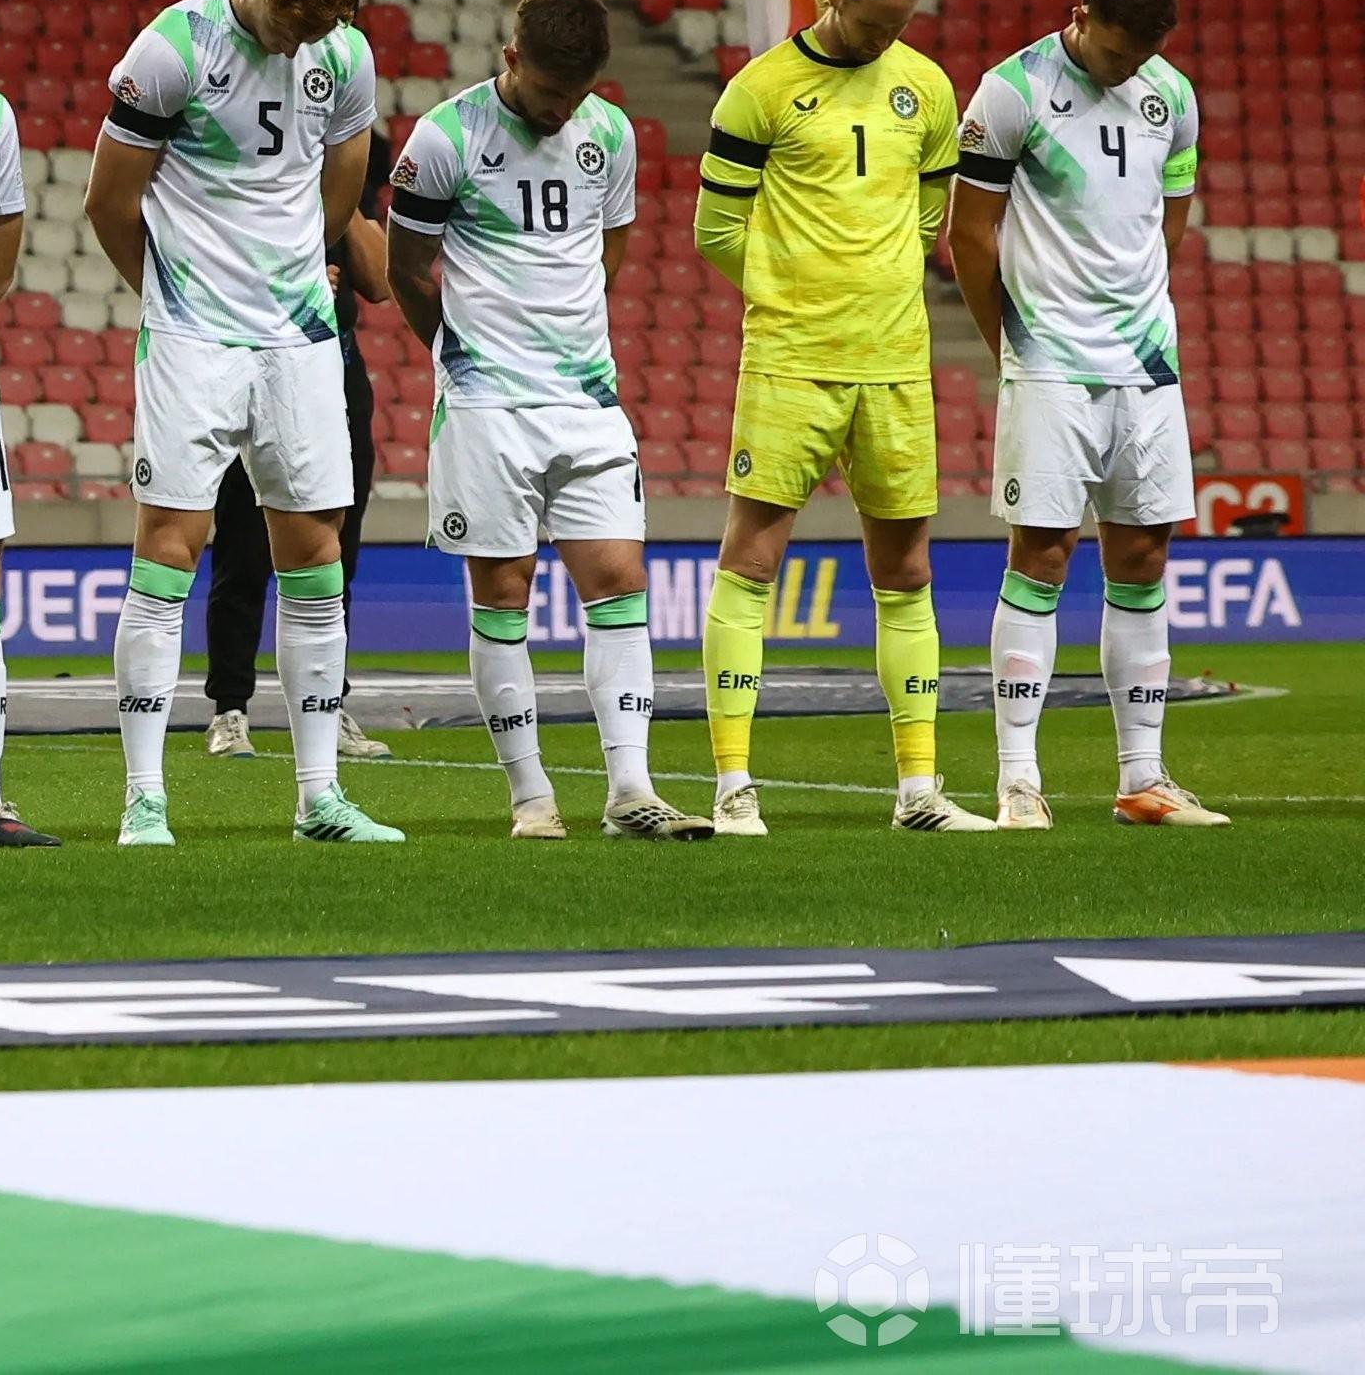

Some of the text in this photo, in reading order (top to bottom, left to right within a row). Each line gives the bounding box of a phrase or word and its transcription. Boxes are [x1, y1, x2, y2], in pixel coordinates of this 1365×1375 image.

[256, 101, 284, 157] 5
[851, 125, 867, 177] 1
[1099, 125, 1126, 178] 4
[516, 179, 569, 233] 18
[1166, 558, 1302, 628] EFA
[905, 675, 939, 694] ÉIR
[997, 679, 1042, 699] ÉIRE
[1128, 686, 1166, 704] ÉIR
[119, 695, 166, 713] ÉIRE
[302, 695, 341, 713] ÉIR
[619, 692, 653, 714] ÉIR
[489, 708, 533, 733] ÉIRE
